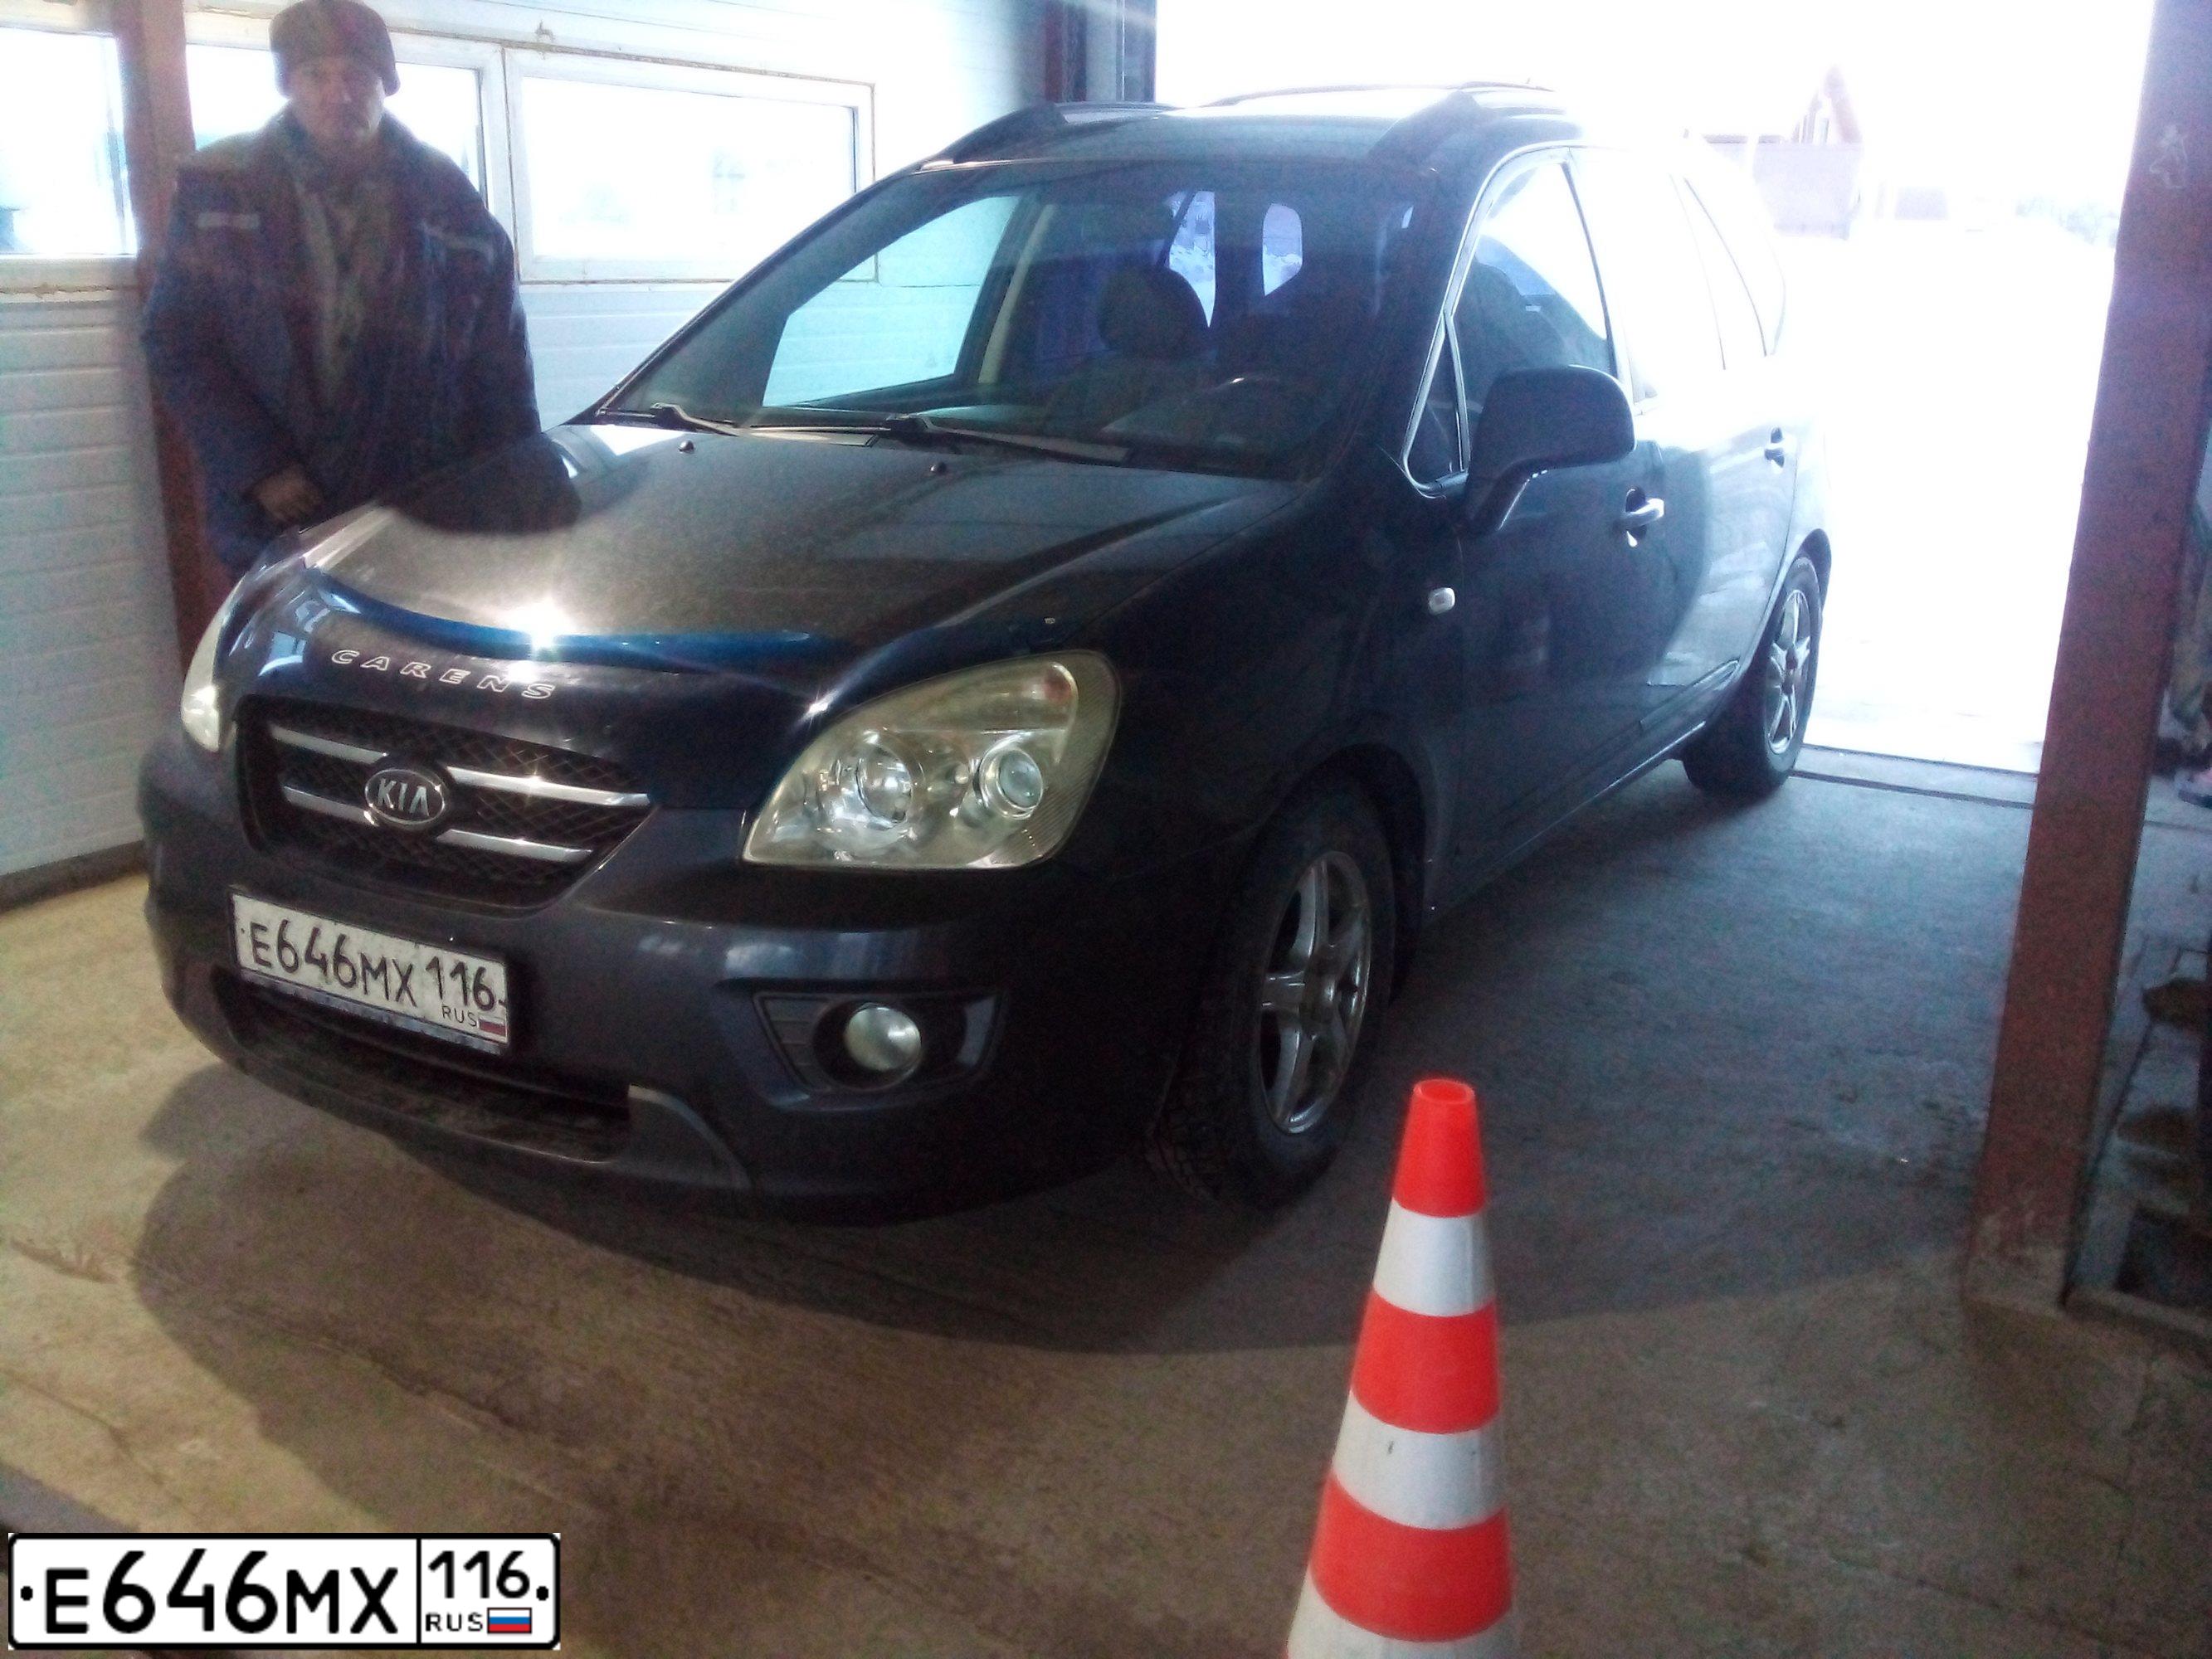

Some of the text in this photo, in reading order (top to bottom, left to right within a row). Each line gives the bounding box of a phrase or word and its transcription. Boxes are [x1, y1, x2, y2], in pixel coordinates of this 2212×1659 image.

[331, 649, 556, 699] CARENS
[376, 777, 430, 816] KIA
[251, 919, 495, 1011] E646MX 116
[441, 1005, 478, 1028] RUS
